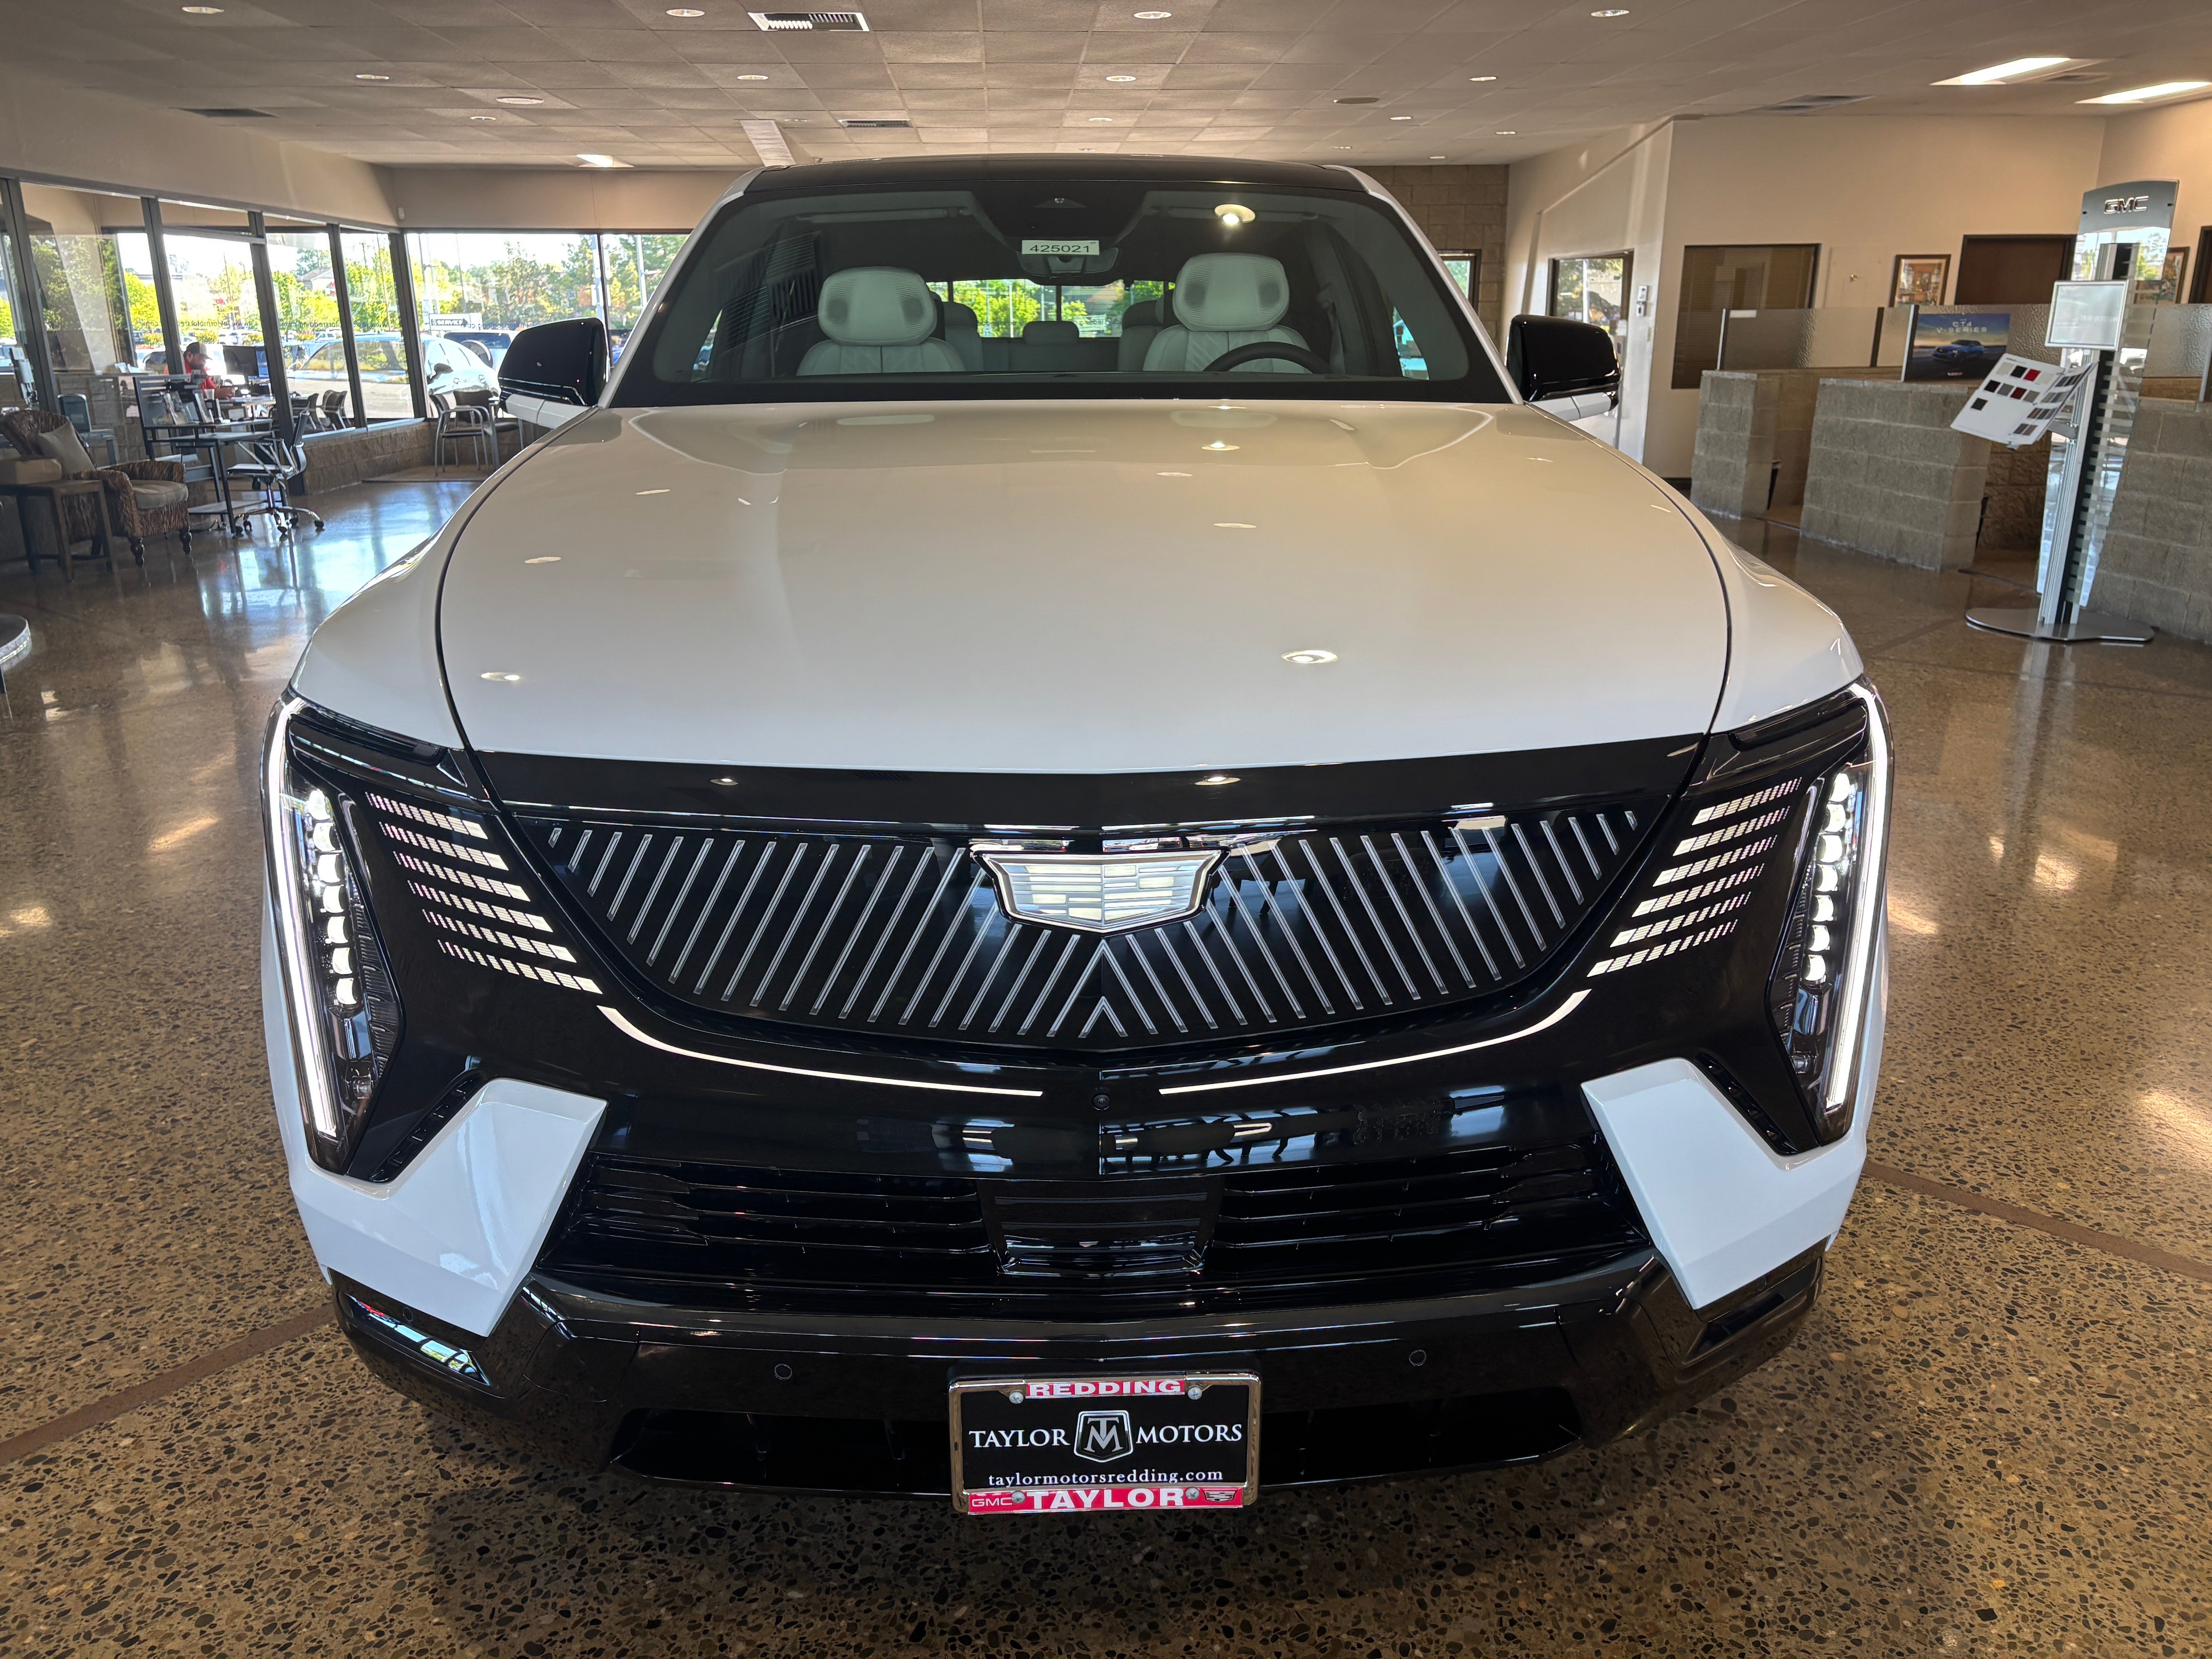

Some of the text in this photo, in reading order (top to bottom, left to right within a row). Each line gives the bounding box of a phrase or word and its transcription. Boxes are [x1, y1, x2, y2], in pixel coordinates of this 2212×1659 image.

[2104, 196, 2149, 214] GMC
[1029, 245, 1089, 253] 425021
[1029, 1380, 1181, 1396] REDDING
[969, 1429, 1071, 1448] TAYLOR
[1135, 1424, 1242, 1444] MOTORS
[988, 1469, 1223, 1488] taylormotorsredding.com
[972, 1488, 1185, 1510] GMC TAYLOR
